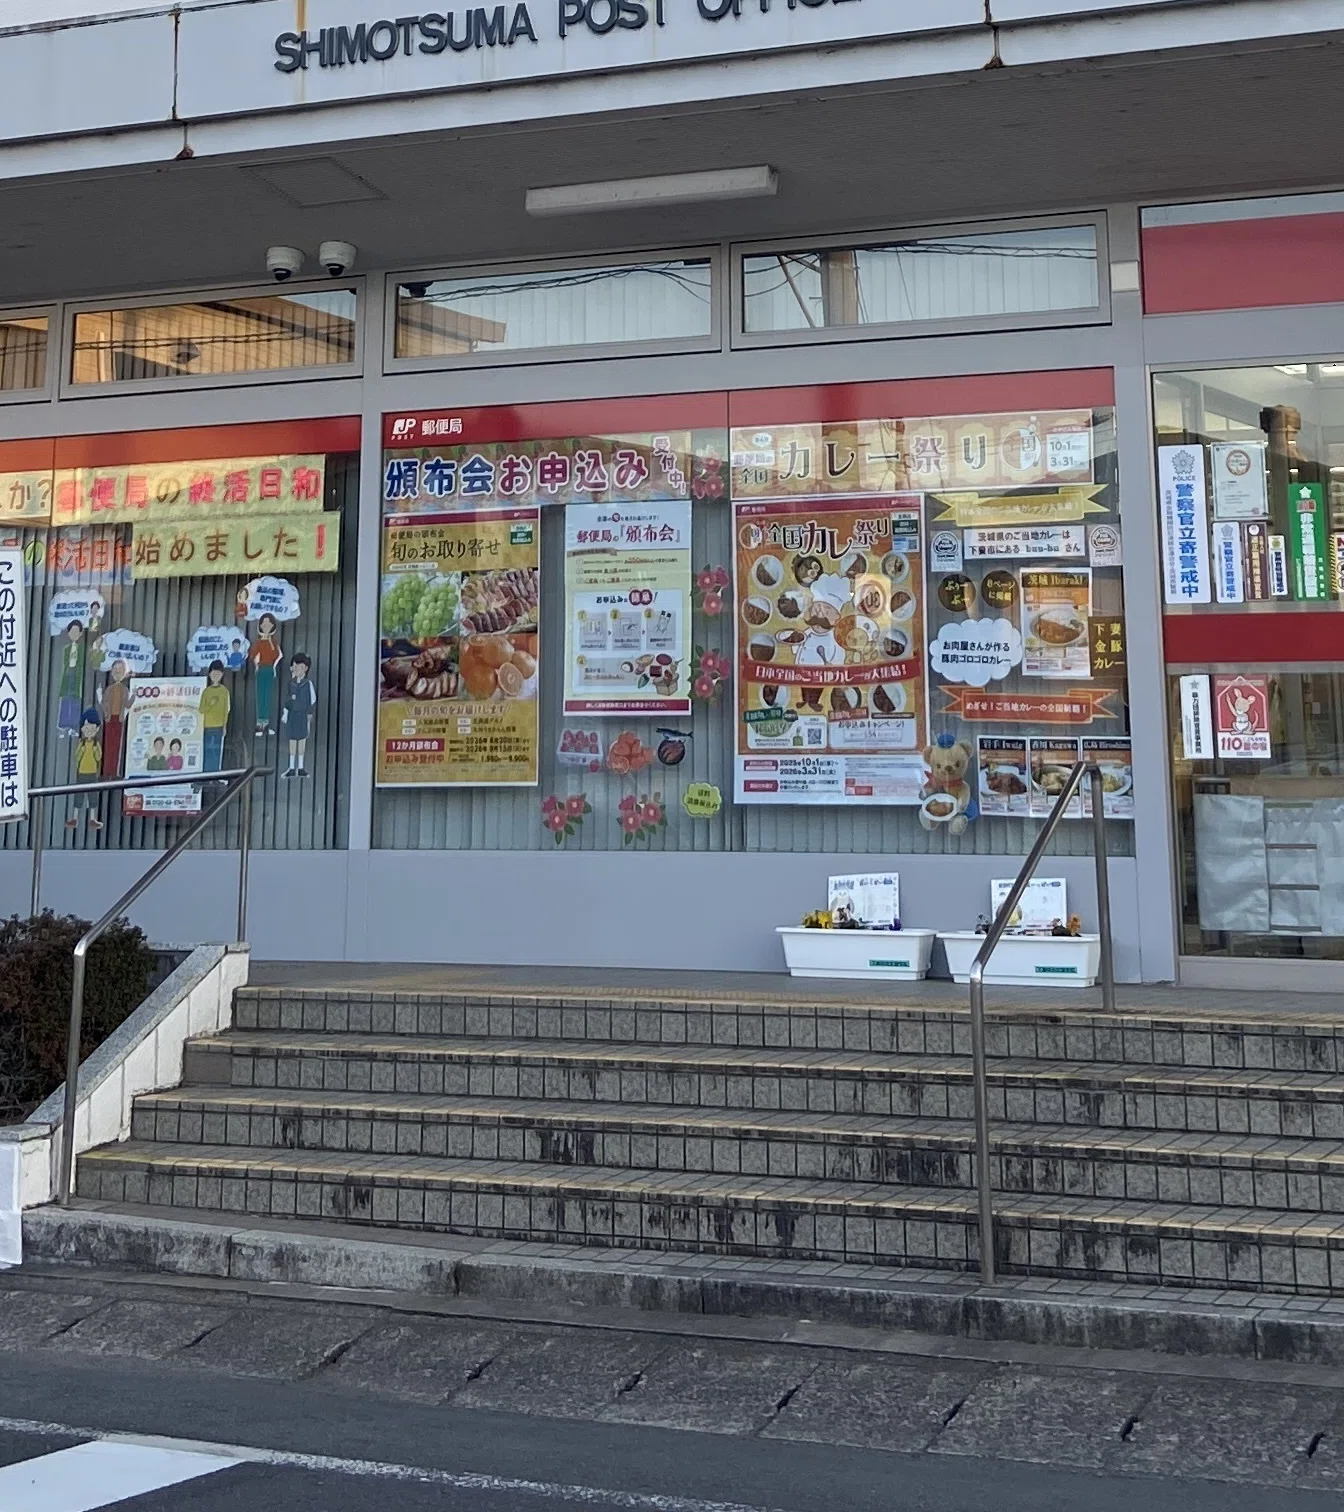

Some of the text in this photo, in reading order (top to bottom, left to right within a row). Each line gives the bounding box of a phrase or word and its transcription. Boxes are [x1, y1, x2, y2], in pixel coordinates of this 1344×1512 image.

[274, 2, 538, 72] SHIMOTSUMA
[421, 418, 463, 436] 郵便局
[384, 449, 649, 500] 頒布会お申込み
[977, 529, 1071, 542] 茨城県のご当地カレーは
[1175, 483, 1200, 599] 警察官立寄警戒中
[134, 523, 326, 567] 始めました！
[390, 537, 502, 562] 旬のお取り寄せ
[968, 544, 1021, 555] 下妻市にある
[1094, 623, 1122, 636] 下妻
[943, 640, 1011, 653] お肉屋さんが作る
[941, 654, 1012, 665] 豚肉ゴロゴロカレー
[1093, 657, 1126, 670] カレー
